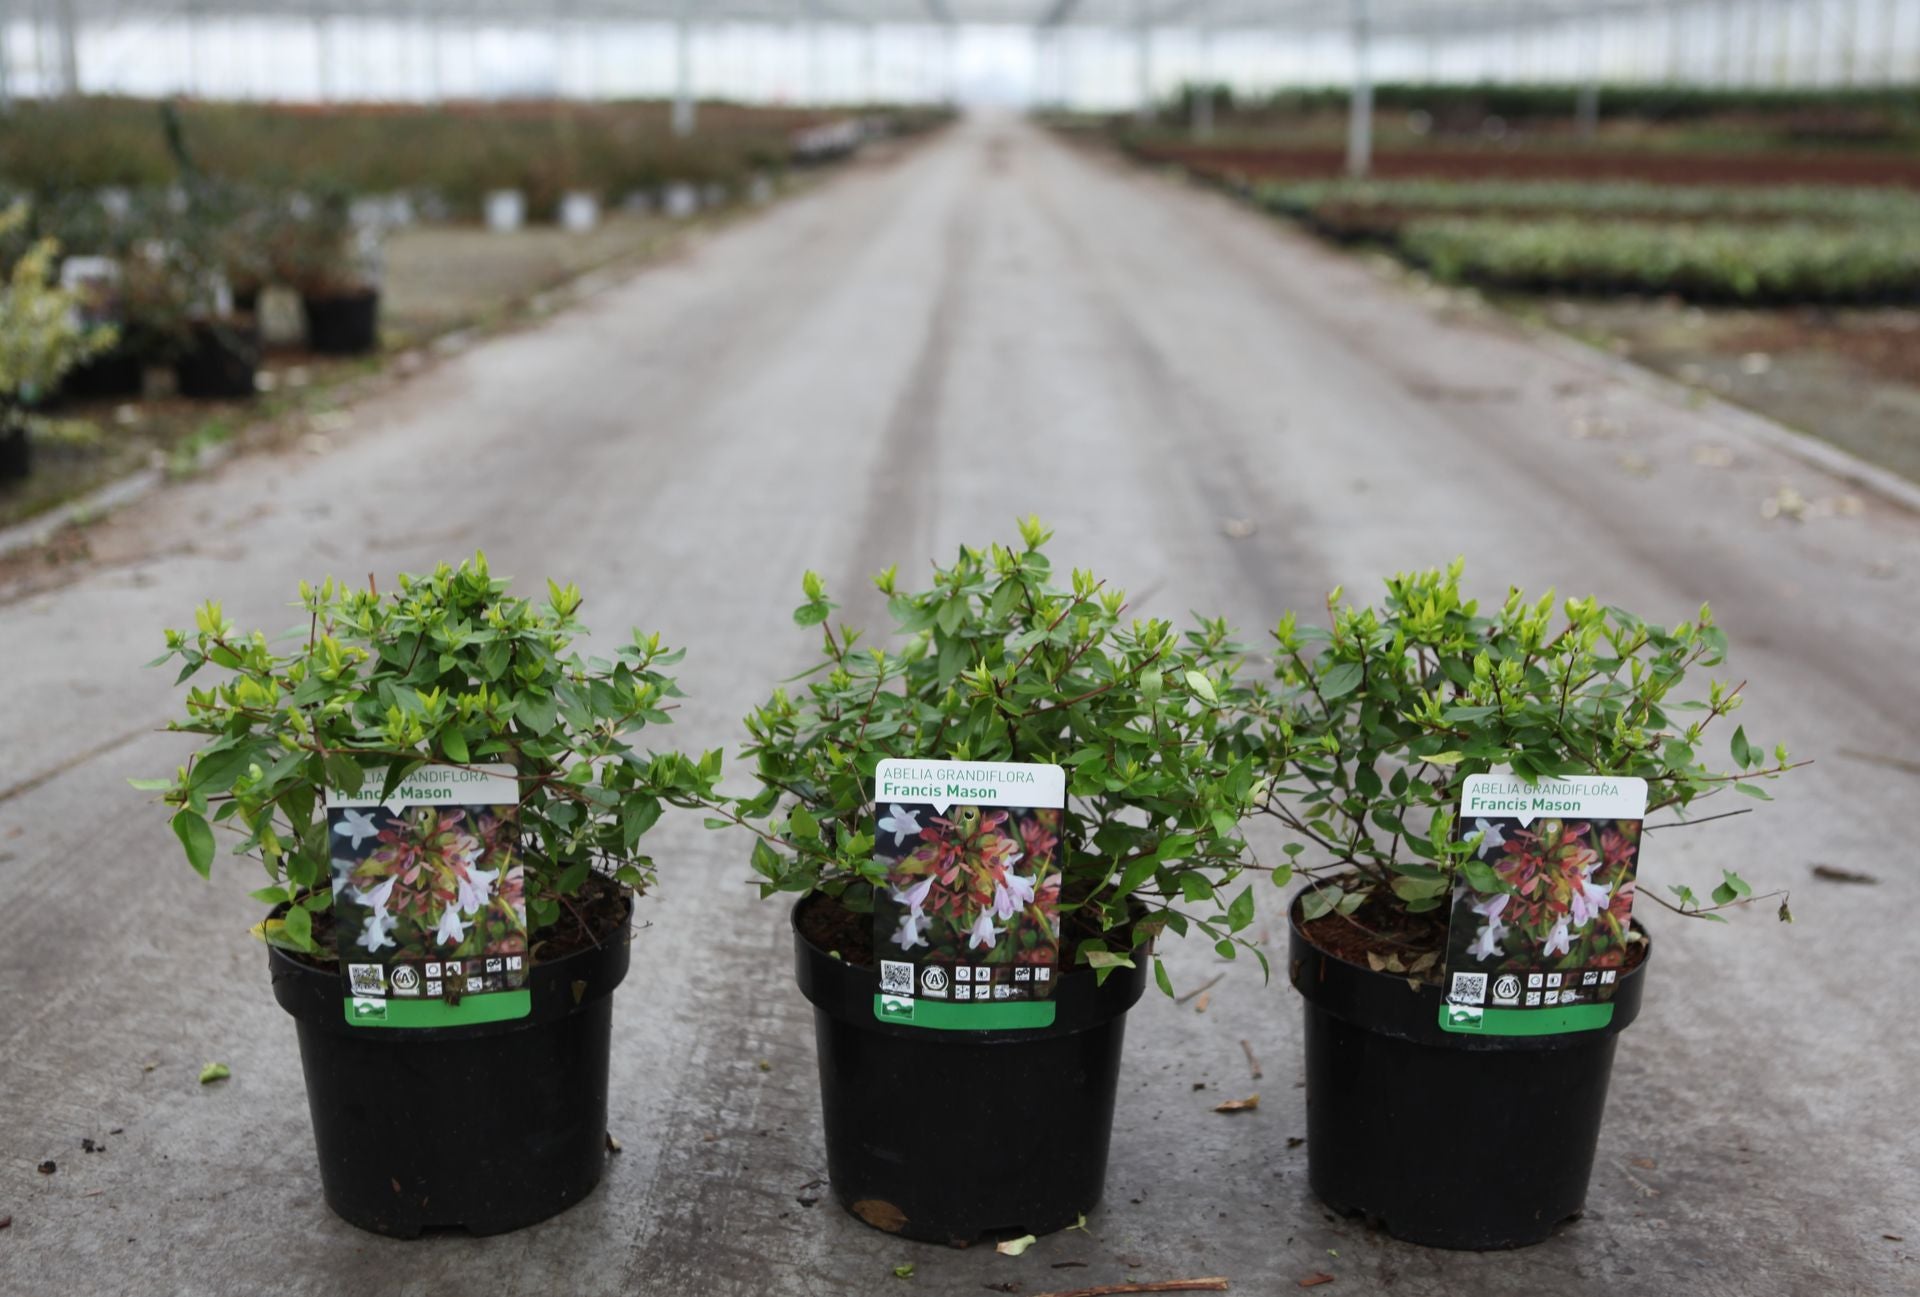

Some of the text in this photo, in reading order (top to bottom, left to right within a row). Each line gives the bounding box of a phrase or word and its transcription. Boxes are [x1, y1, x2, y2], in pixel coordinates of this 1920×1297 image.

[401, 770, 489, 784] ANDIFLORA
[883, 767, 1035, 784] ABELIA GRANDIFLORA
[400, 785, 452, 799] Mason
[884, 782, 997, 798] Francis Mason
[1471, 782, 1619, 796] ABELIA GRANDIFLORA
[1471, 797, 1581, 811] Francis Mason
